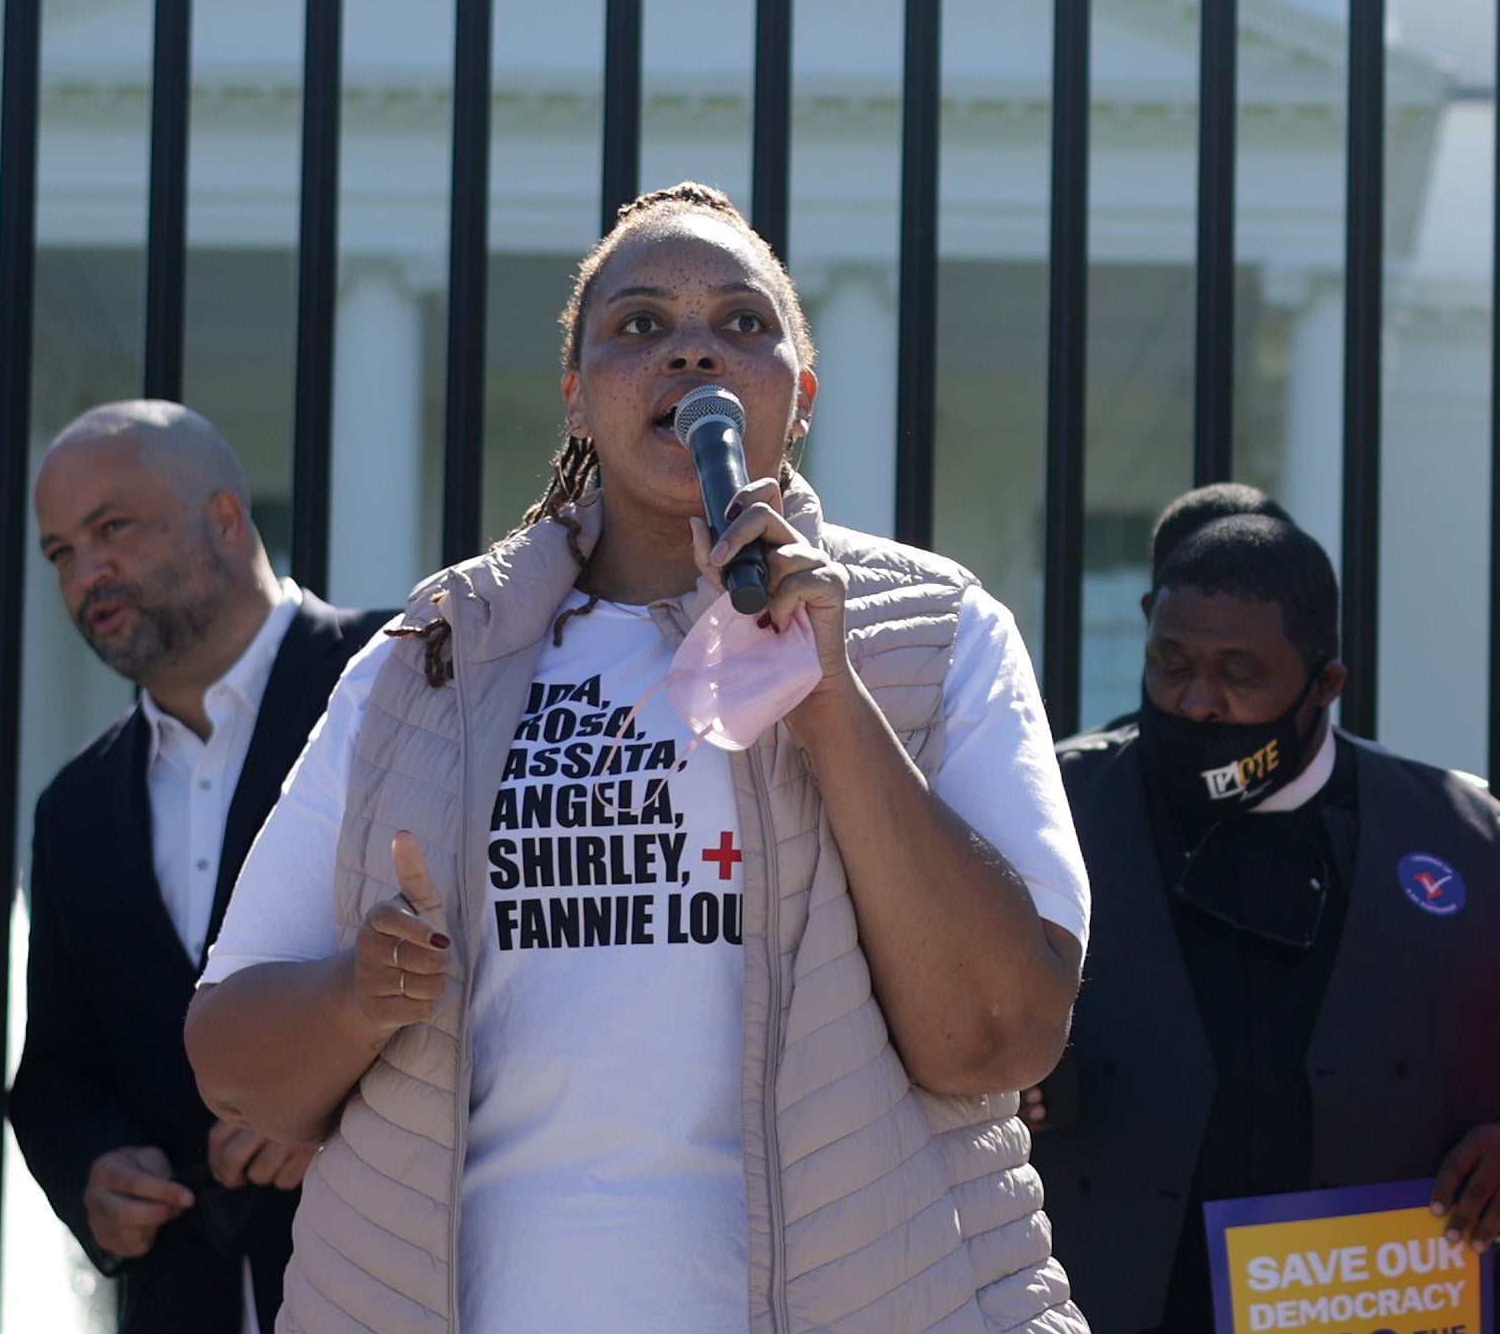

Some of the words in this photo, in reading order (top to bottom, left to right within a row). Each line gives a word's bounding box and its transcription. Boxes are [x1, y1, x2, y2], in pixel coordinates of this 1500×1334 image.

[525, 673, 611, 714] IDA,
[514, 706, 646, 743] ROSA,
[501, 739, 688, 782] ASSATA,
[490, 778, 684, 831] ANGELA,
[488, 832, 690, 890] SHIRLEY,
[495, 895, 654, 951] FANNIE
[668, 891, 743, 945] LOU
[1247, 1246, 1368, 1291] SAVE
[1377, 1237, 1465, 1281] OUR
[1249, 1281, 1465, 1330] DEMOCRACY
